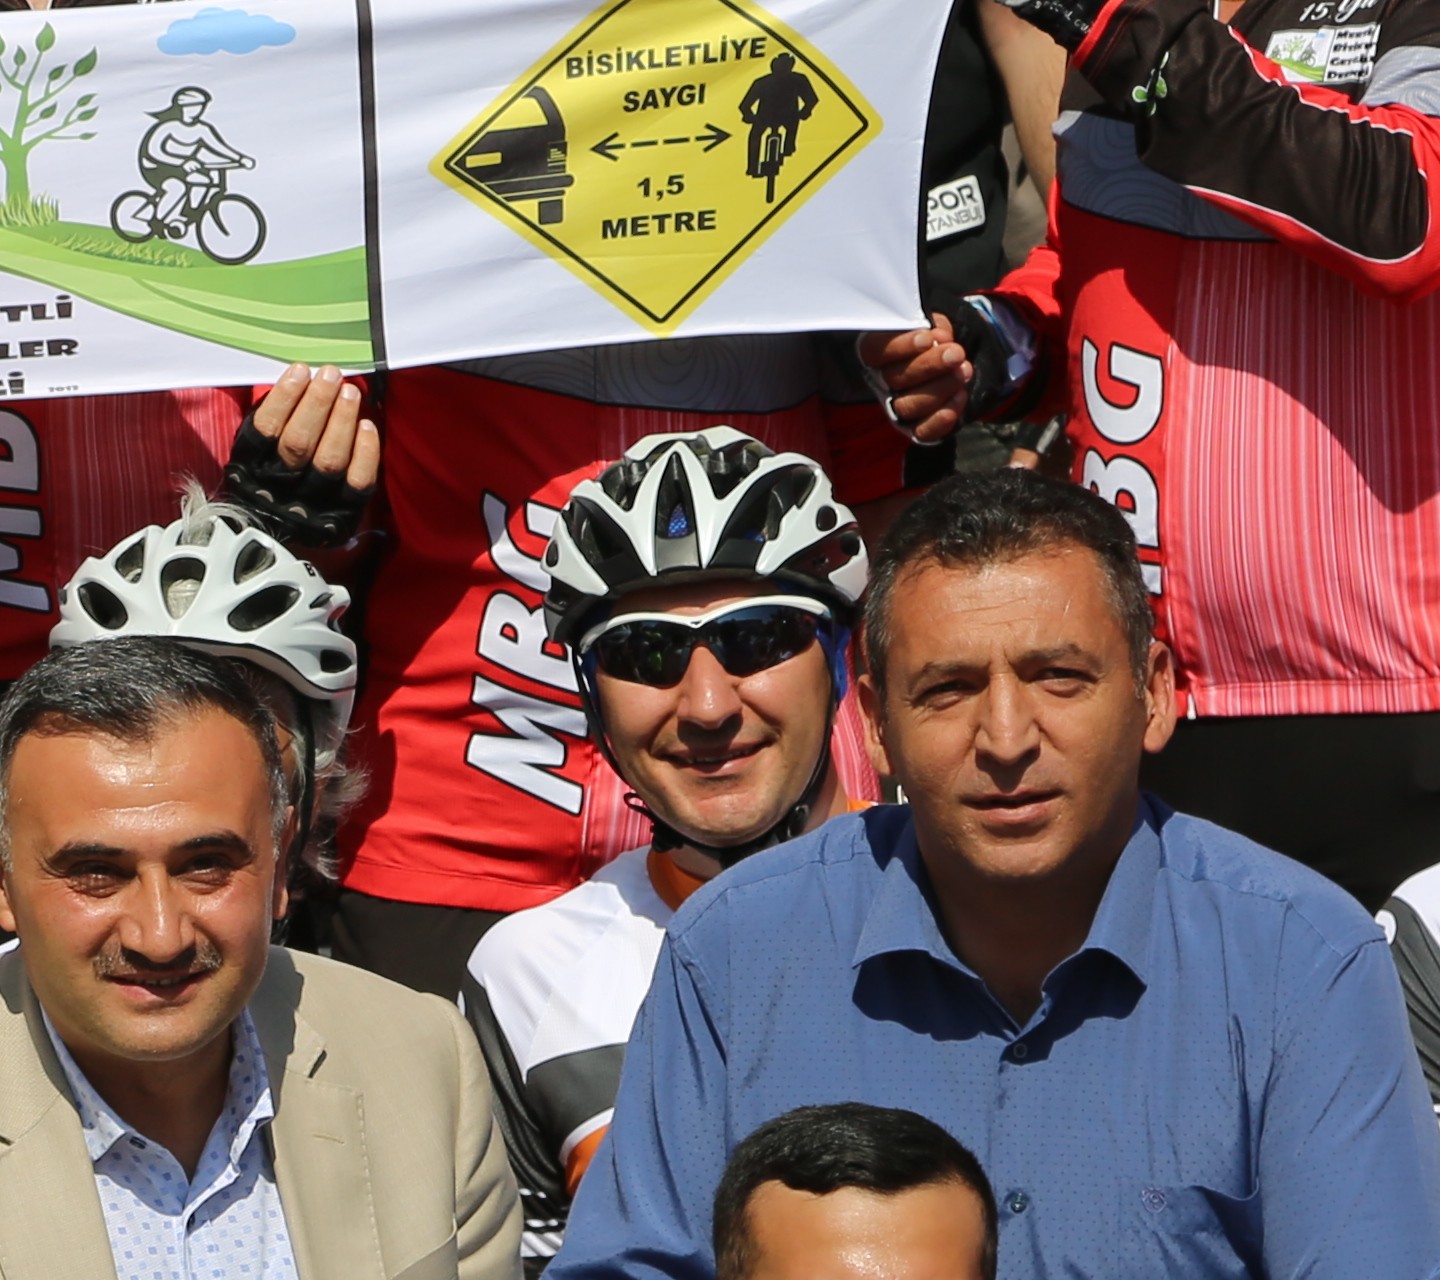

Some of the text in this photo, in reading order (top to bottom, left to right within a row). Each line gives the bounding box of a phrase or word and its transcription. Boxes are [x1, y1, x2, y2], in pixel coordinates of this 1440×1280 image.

[564, 34, 768, 80] BİSİKLETLİYE
[623, 83, 707, 114] SAYGI
[636, 173, 685, 202] 1,5
[928, 182, 978, 211] POR
[600, 209, 718, 240] METRE
[1081, 334, 1166, 570] BG
